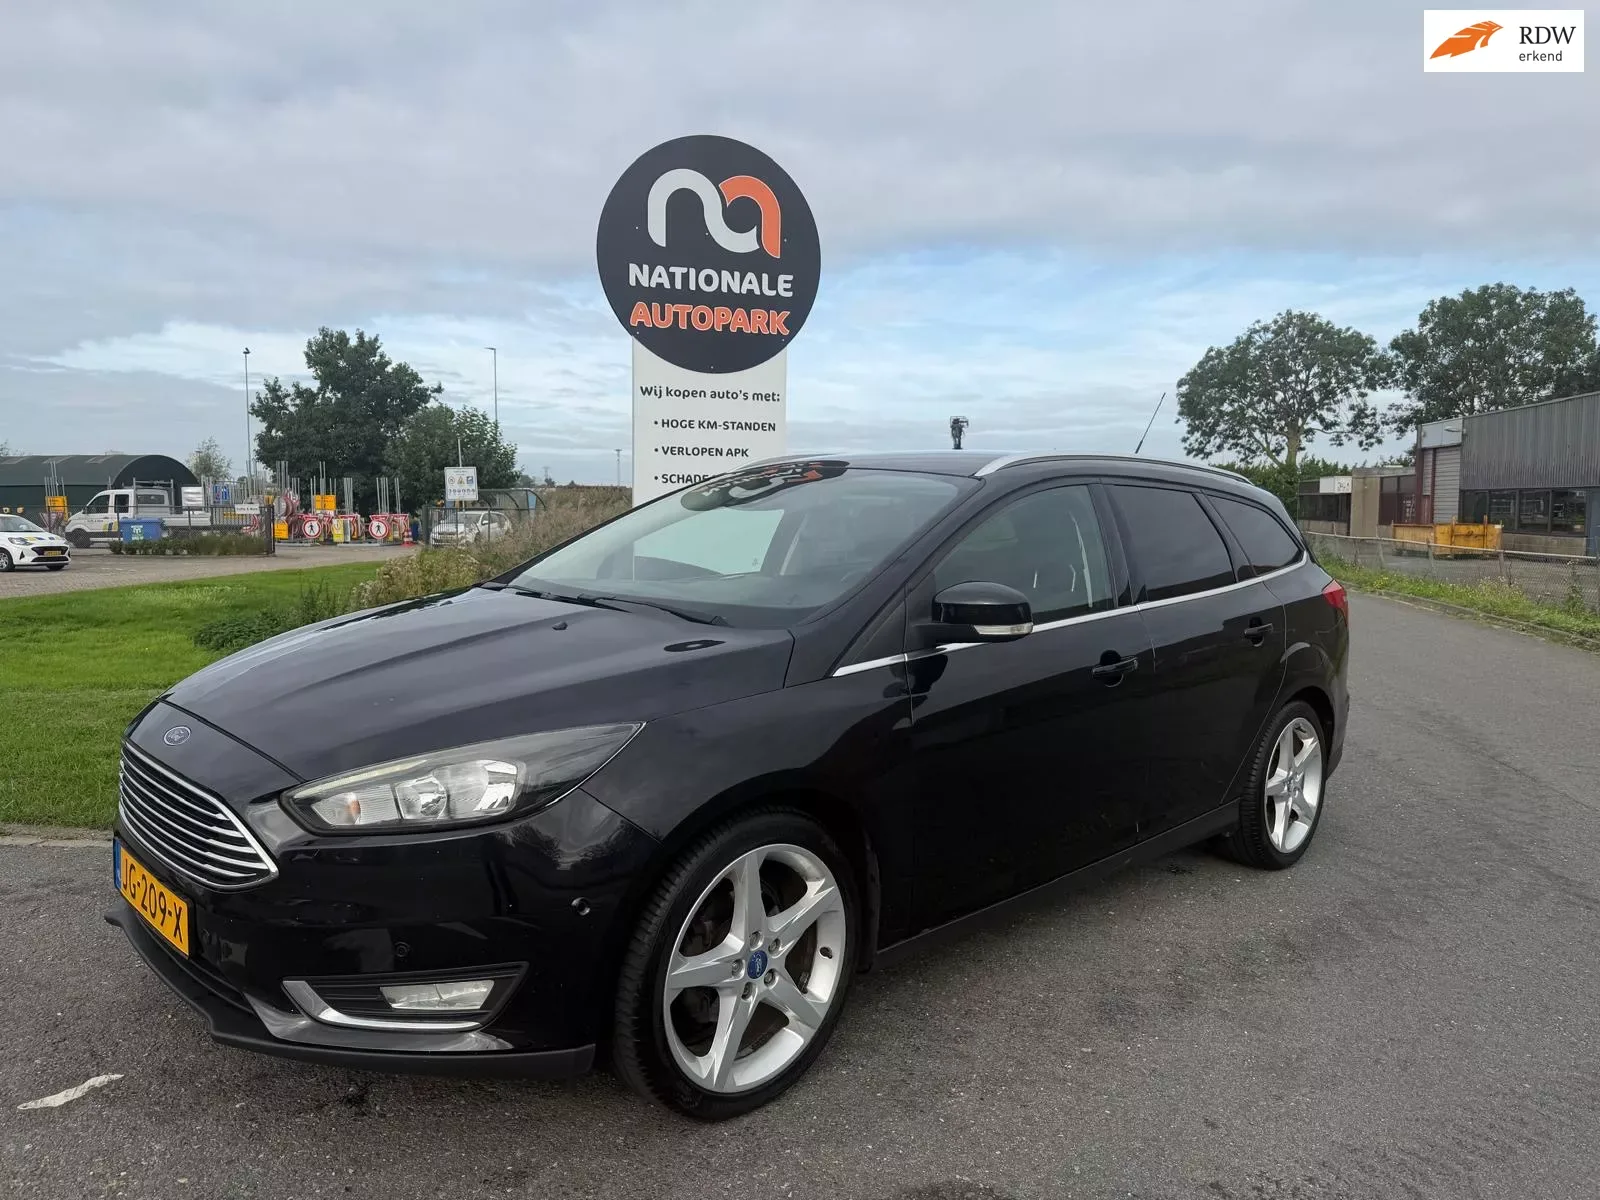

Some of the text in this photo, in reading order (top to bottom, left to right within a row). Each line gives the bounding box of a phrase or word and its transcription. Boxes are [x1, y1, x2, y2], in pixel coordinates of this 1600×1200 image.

[628, 263, 794, 297] NATIONALE
[629, 301, 790, 335] AUTOPARK
[640, 386, 780, 402] Wij kopen auto's met:
[661, 419, 776, 432] HOGE KM-STANDEN
[661, 446, 749, 457] VERLOPEN APK
[122, 858, 184, 944] JG-209-X
